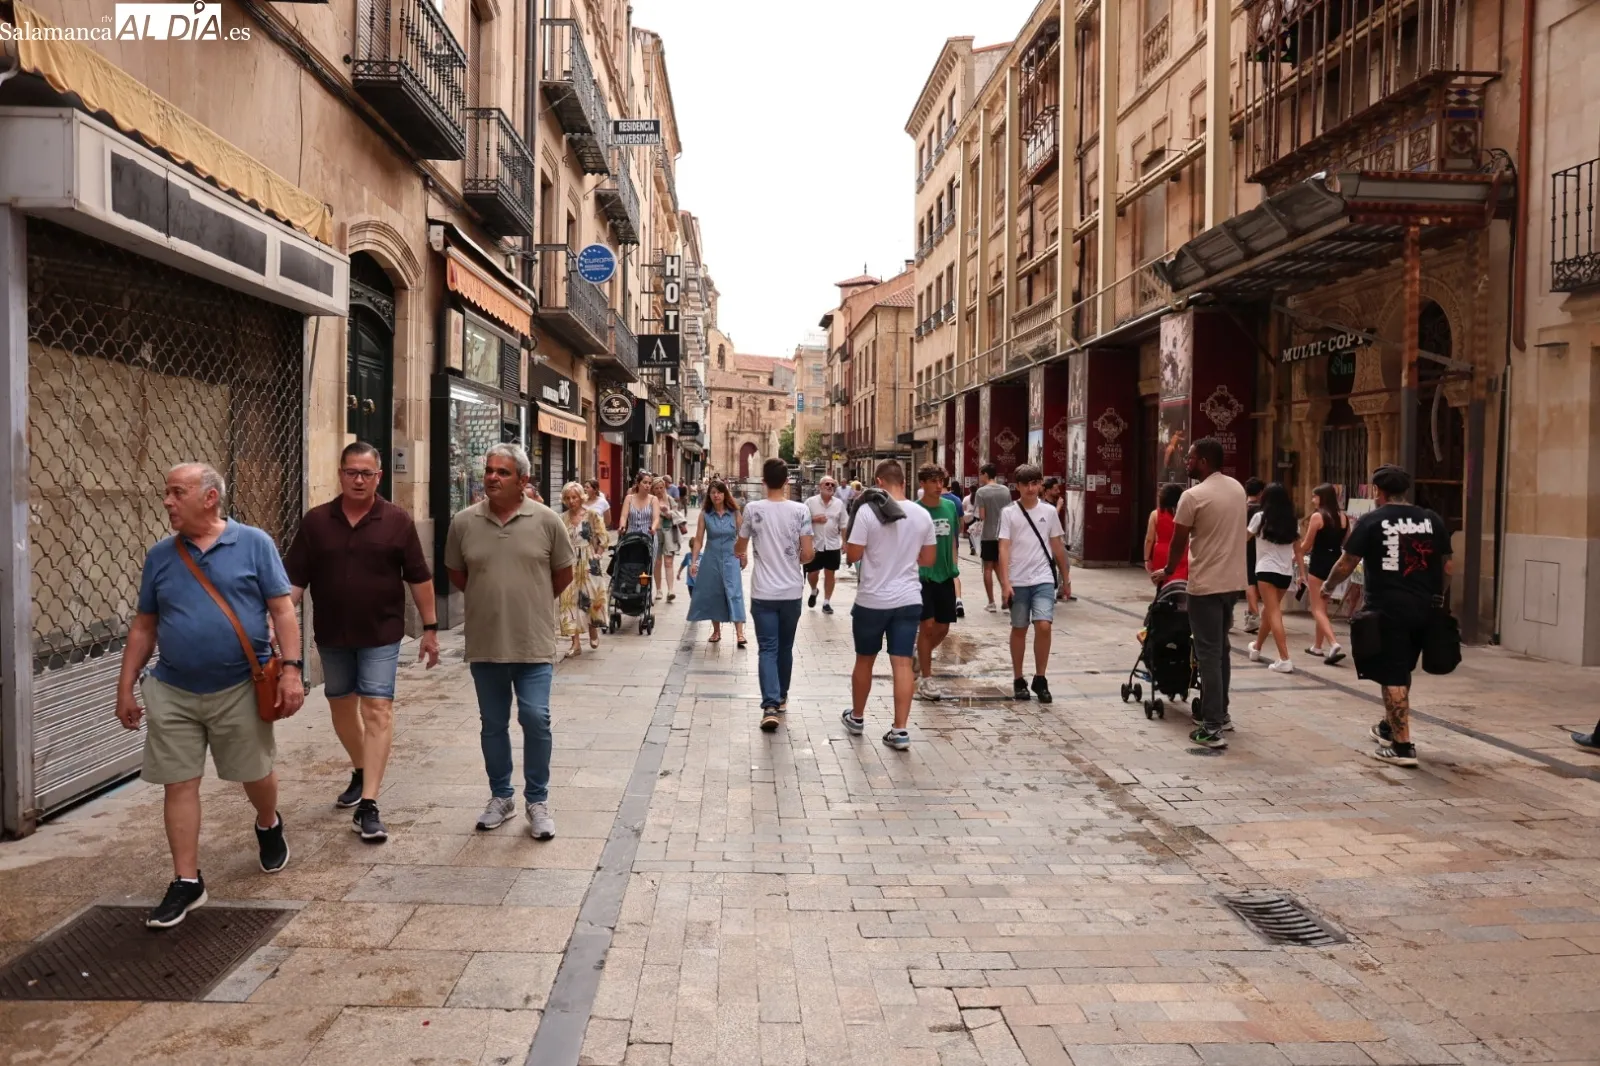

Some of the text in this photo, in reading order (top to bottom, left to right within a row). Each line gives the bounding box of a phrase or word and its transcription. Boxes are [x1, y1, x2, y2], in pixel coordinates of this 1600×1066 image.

[619, 121, 654, 132] RESIDENCIA
[615, 133, 659, 144] UNIVERSITARIA
[664, 256, 680, 386] HOTL
[1381, 517, 1433, 535] Sabbat
